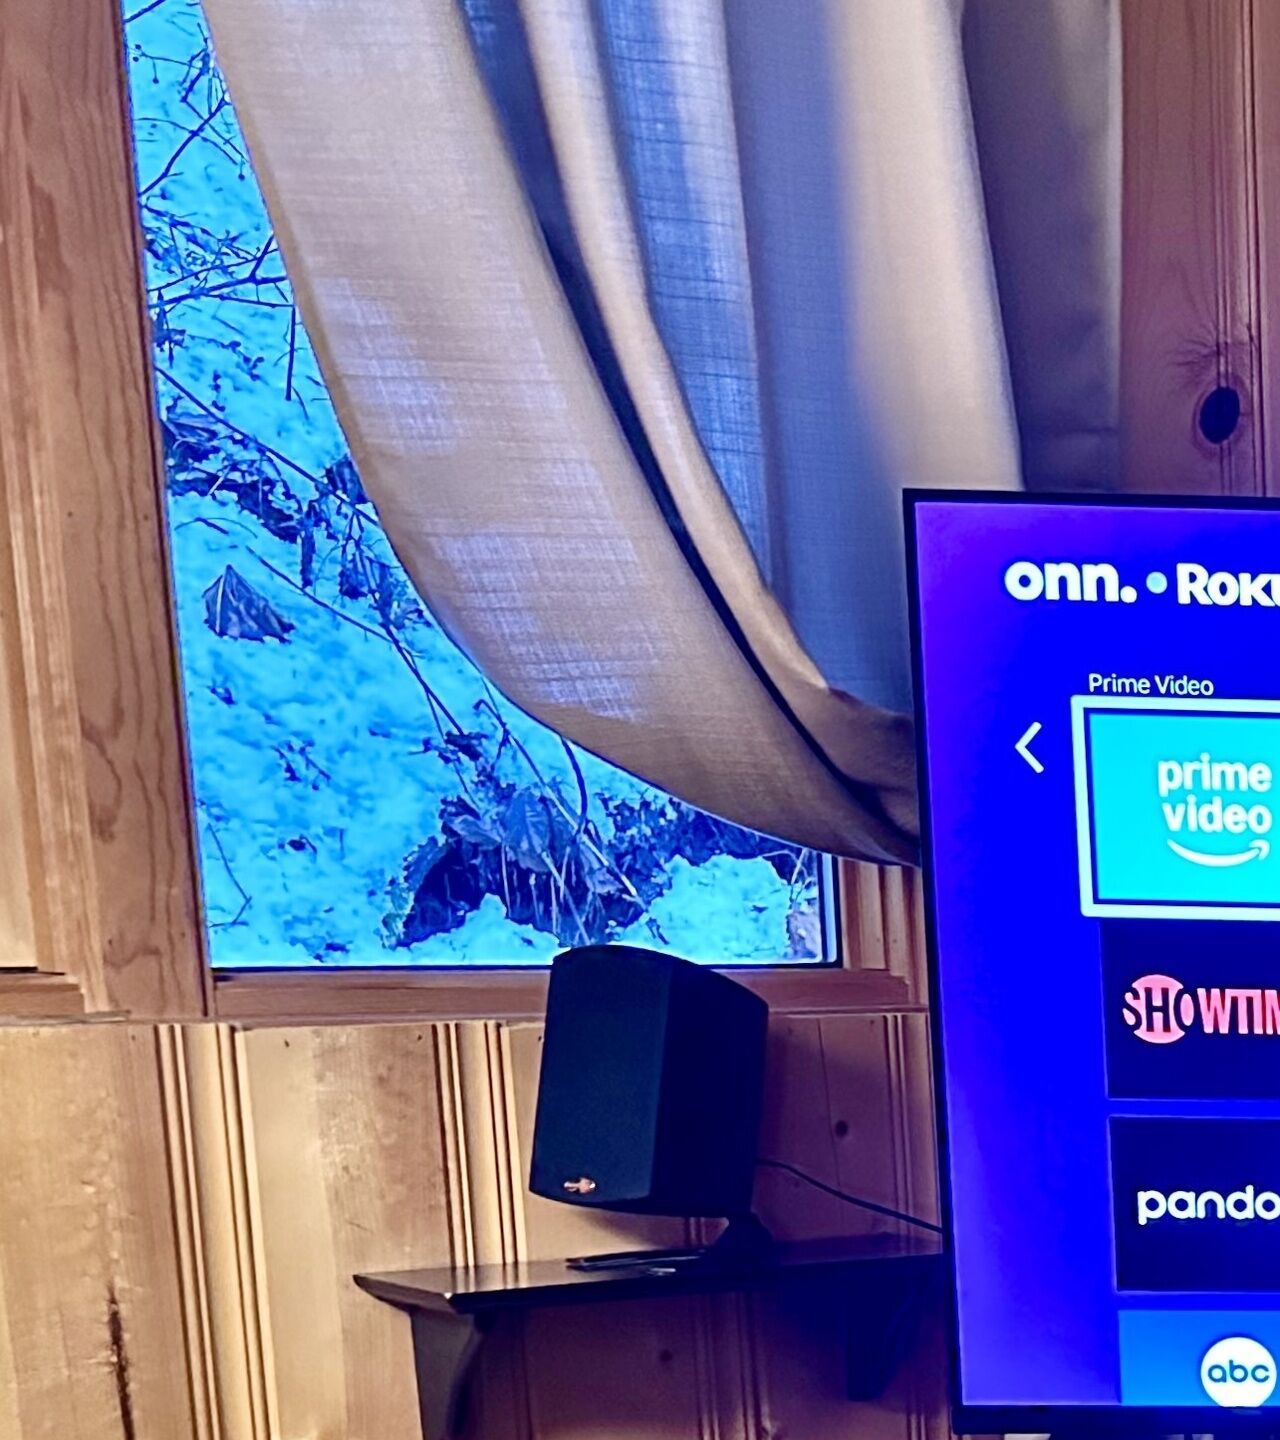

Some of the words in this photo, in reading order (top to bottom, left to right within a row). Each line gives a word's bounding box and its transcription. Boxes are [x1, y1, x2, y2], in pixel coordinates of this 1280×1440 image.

[1005, 561, 1138, 603] onn.
[1088, 673, 1151, 695] Prime
[1154, 675, 1214, 696] Video
[1158, 752, 1273, 797] prime
[1161, 794, 1273, 834] video
[1207, 1359, 1271, 1384] abc
